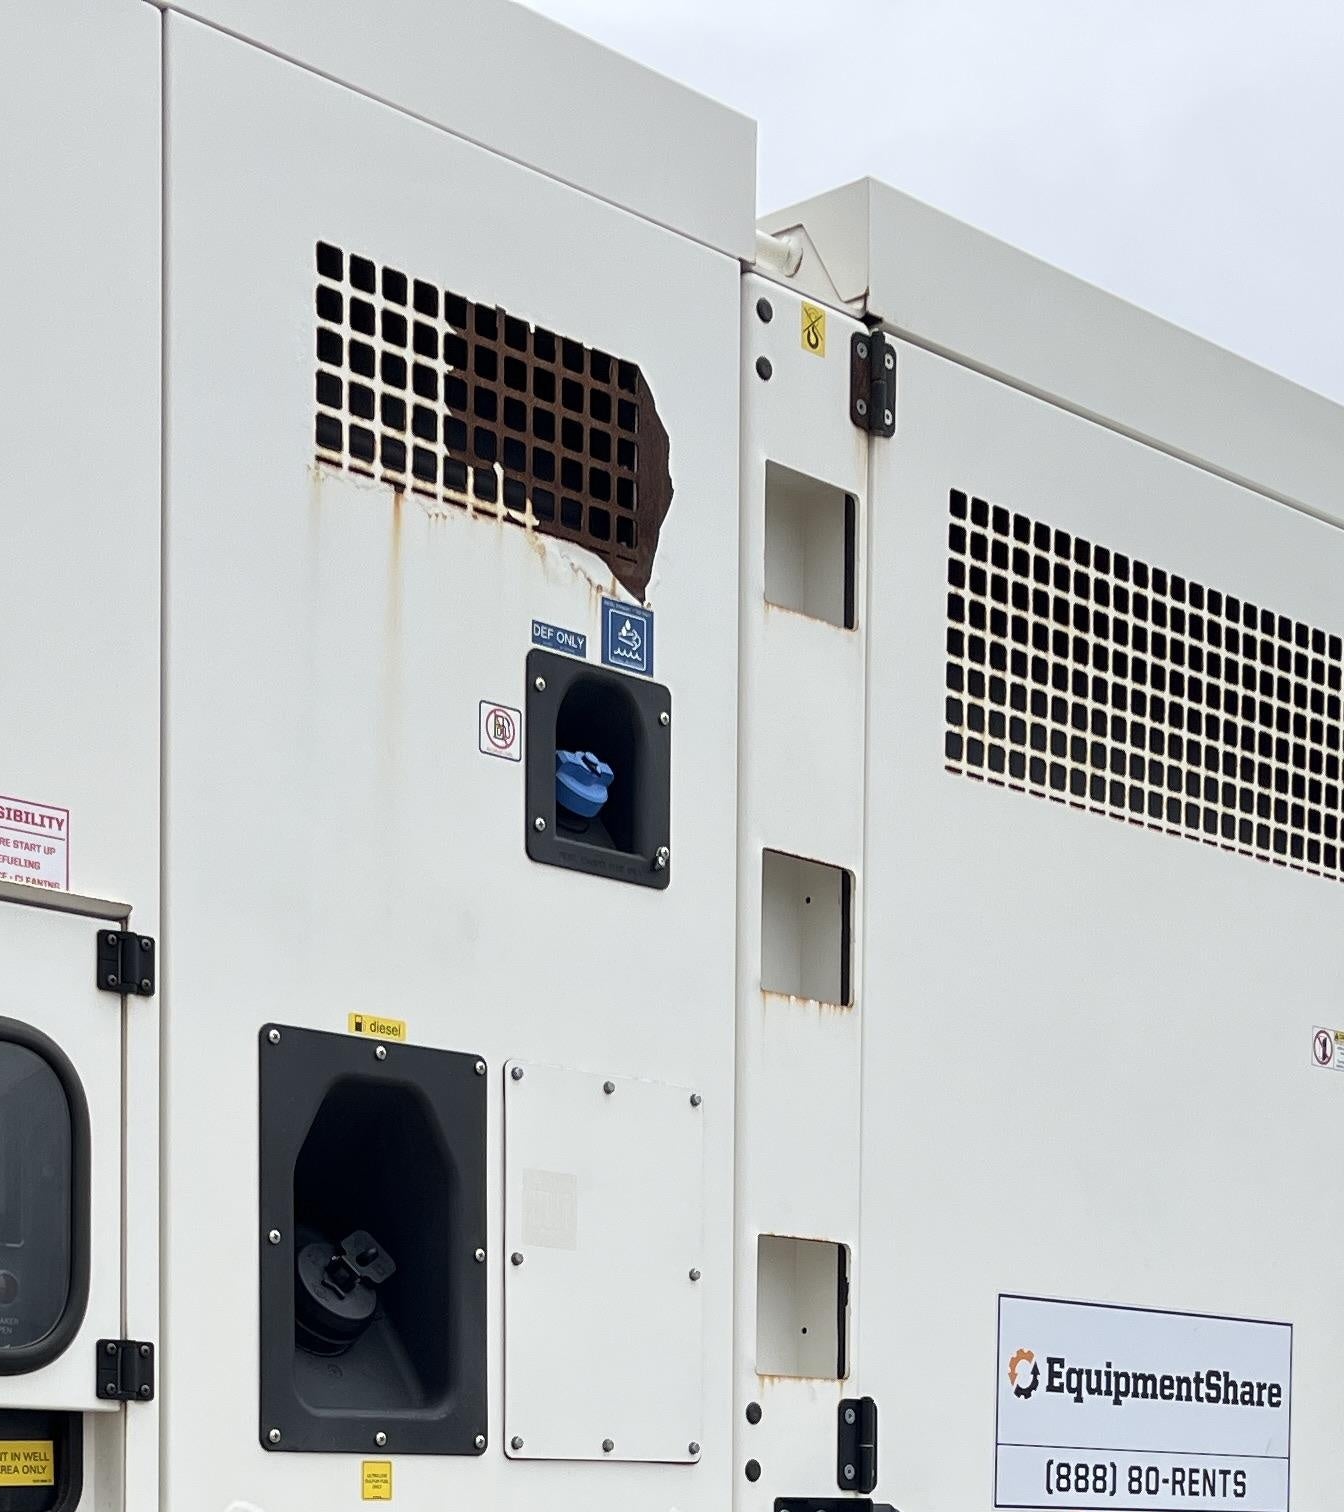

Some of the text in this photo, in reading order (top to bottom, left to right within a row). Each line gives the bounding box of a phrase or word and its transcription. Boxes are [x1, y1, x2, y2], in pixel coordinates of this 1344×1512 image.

[533, 623, 554, 639] DEF
[556, 630, 586, 650] ONLY
[12, 839, 41, 853] START
[43, 845, 57, 856] UP
[369, 1020, 401, 1038] diesel
[1045, 1356, 1282, 1408] EquipmentShare
[10, 1451, 20, 1462] IN
[22, 1451, 50, 1462] WELL
[22, 1464, 47, 1475] ONLY
[1045, 1459, 1247, 1498] (888) 80-RENTS
